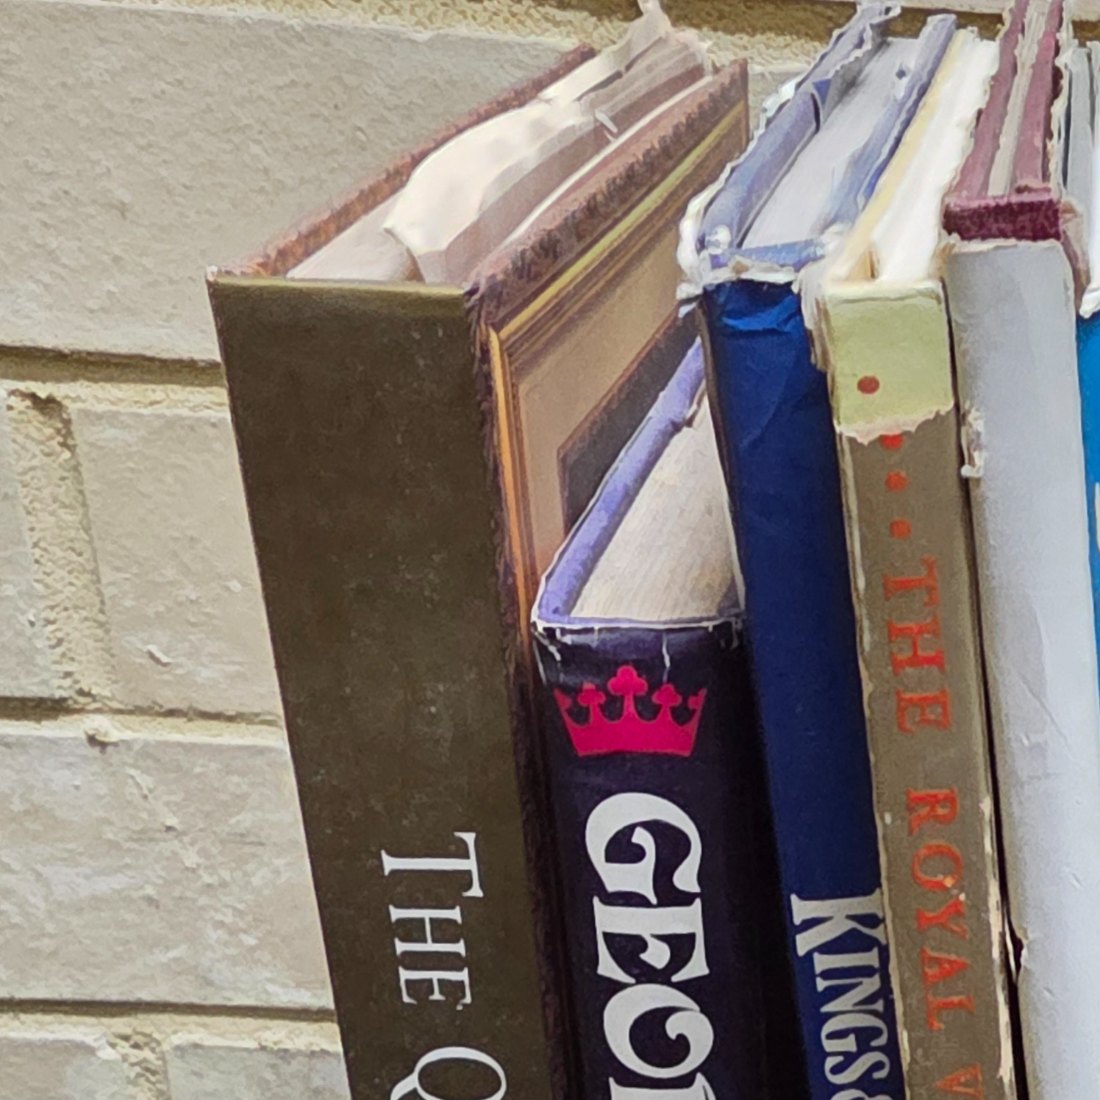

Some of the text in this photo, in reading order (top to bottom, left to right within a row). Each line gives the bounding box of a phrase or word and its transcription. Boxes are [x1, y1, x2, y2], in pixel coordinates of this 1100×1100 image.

[882, 555, 950, 735] THE
[381, 831, 484, 1010] THE
[904, 787, 976, 1032] ROYAL
